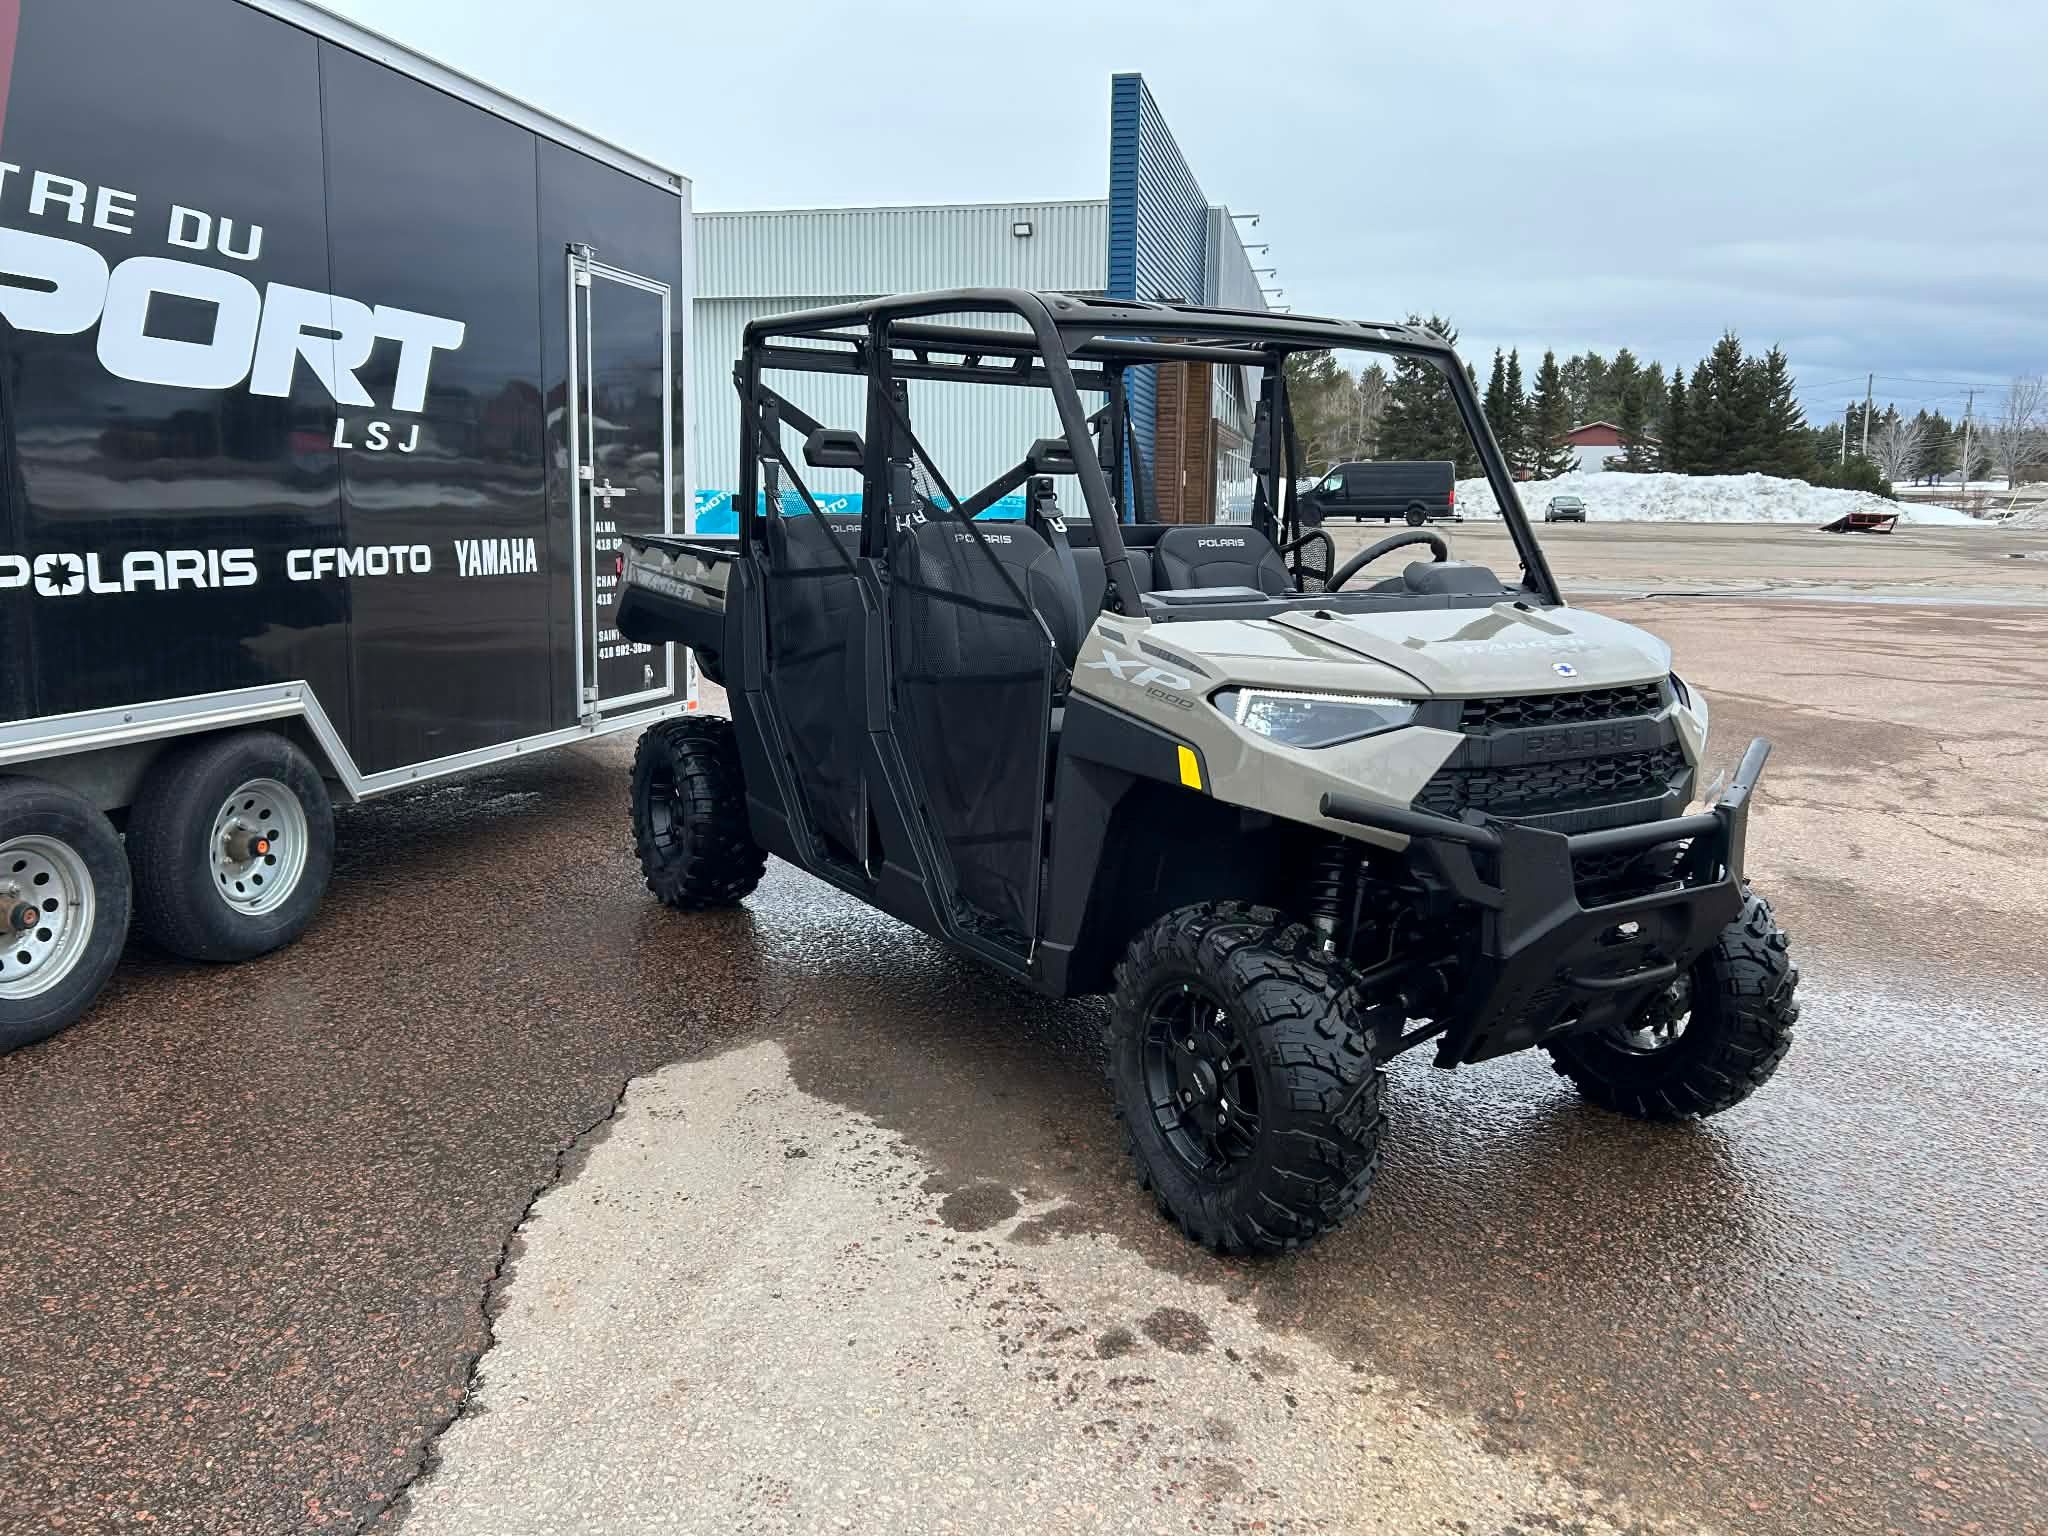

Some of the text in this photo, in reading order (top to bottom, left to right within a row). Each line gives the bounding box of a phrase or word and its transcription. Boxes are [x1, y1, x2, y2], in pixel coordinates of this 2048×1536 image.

[167, 204, 263, 261] DU
[333, 418, 419, 452] LSJ
[595, 521, 617, 533] ALMA
[596, 539, 612, 551] 418
[1198, 538, 1246, 548] POLARIS
[0, 537, 538, 597] POLARIS CFMOTO YAMAHA
[597, 593, 613, 606] 418
[1081, 649, 1191, 690] XP
[1146, 687, 1196, 710] 1000
